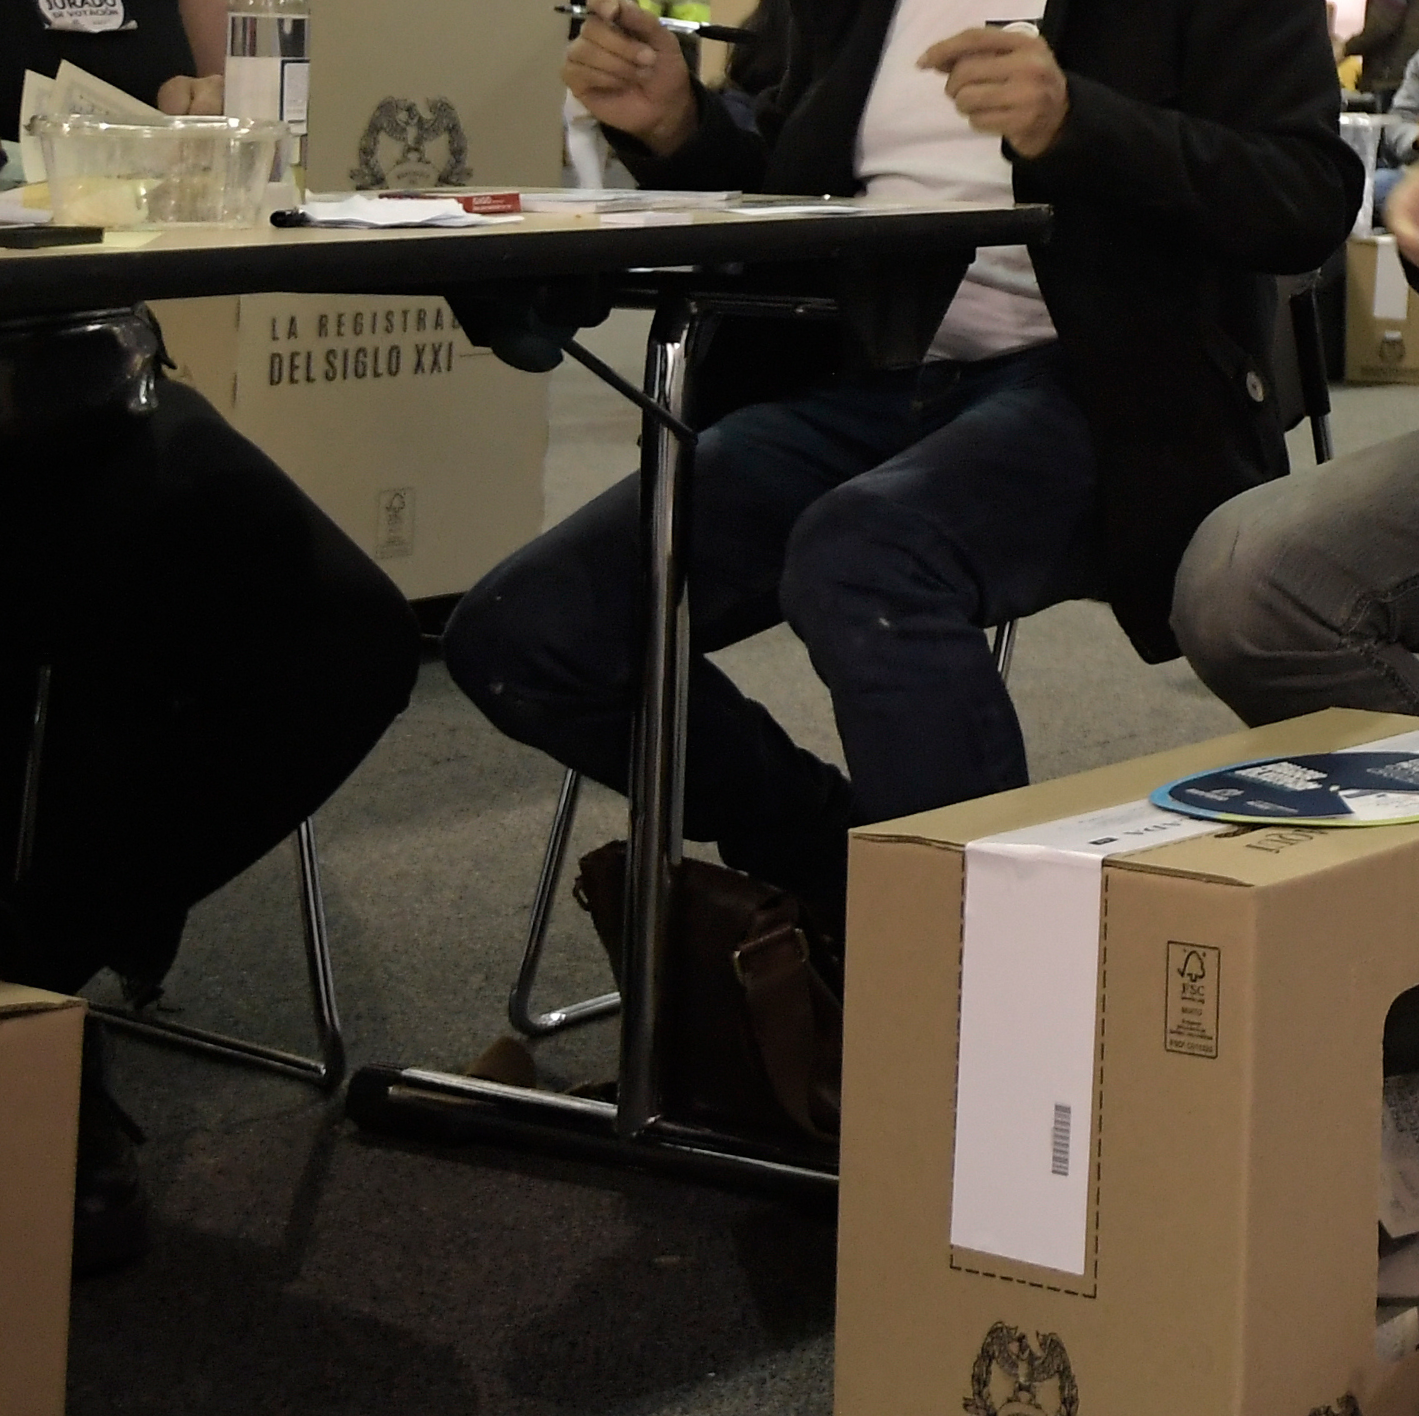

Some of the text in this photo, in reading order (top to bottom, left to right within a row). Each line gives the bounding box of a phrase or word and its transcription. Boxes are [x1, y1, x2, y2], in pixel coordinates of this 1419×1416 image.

[271, 315, 299, 342] LA
[269, 341, 455, 386] DEL SIGLO XXI
